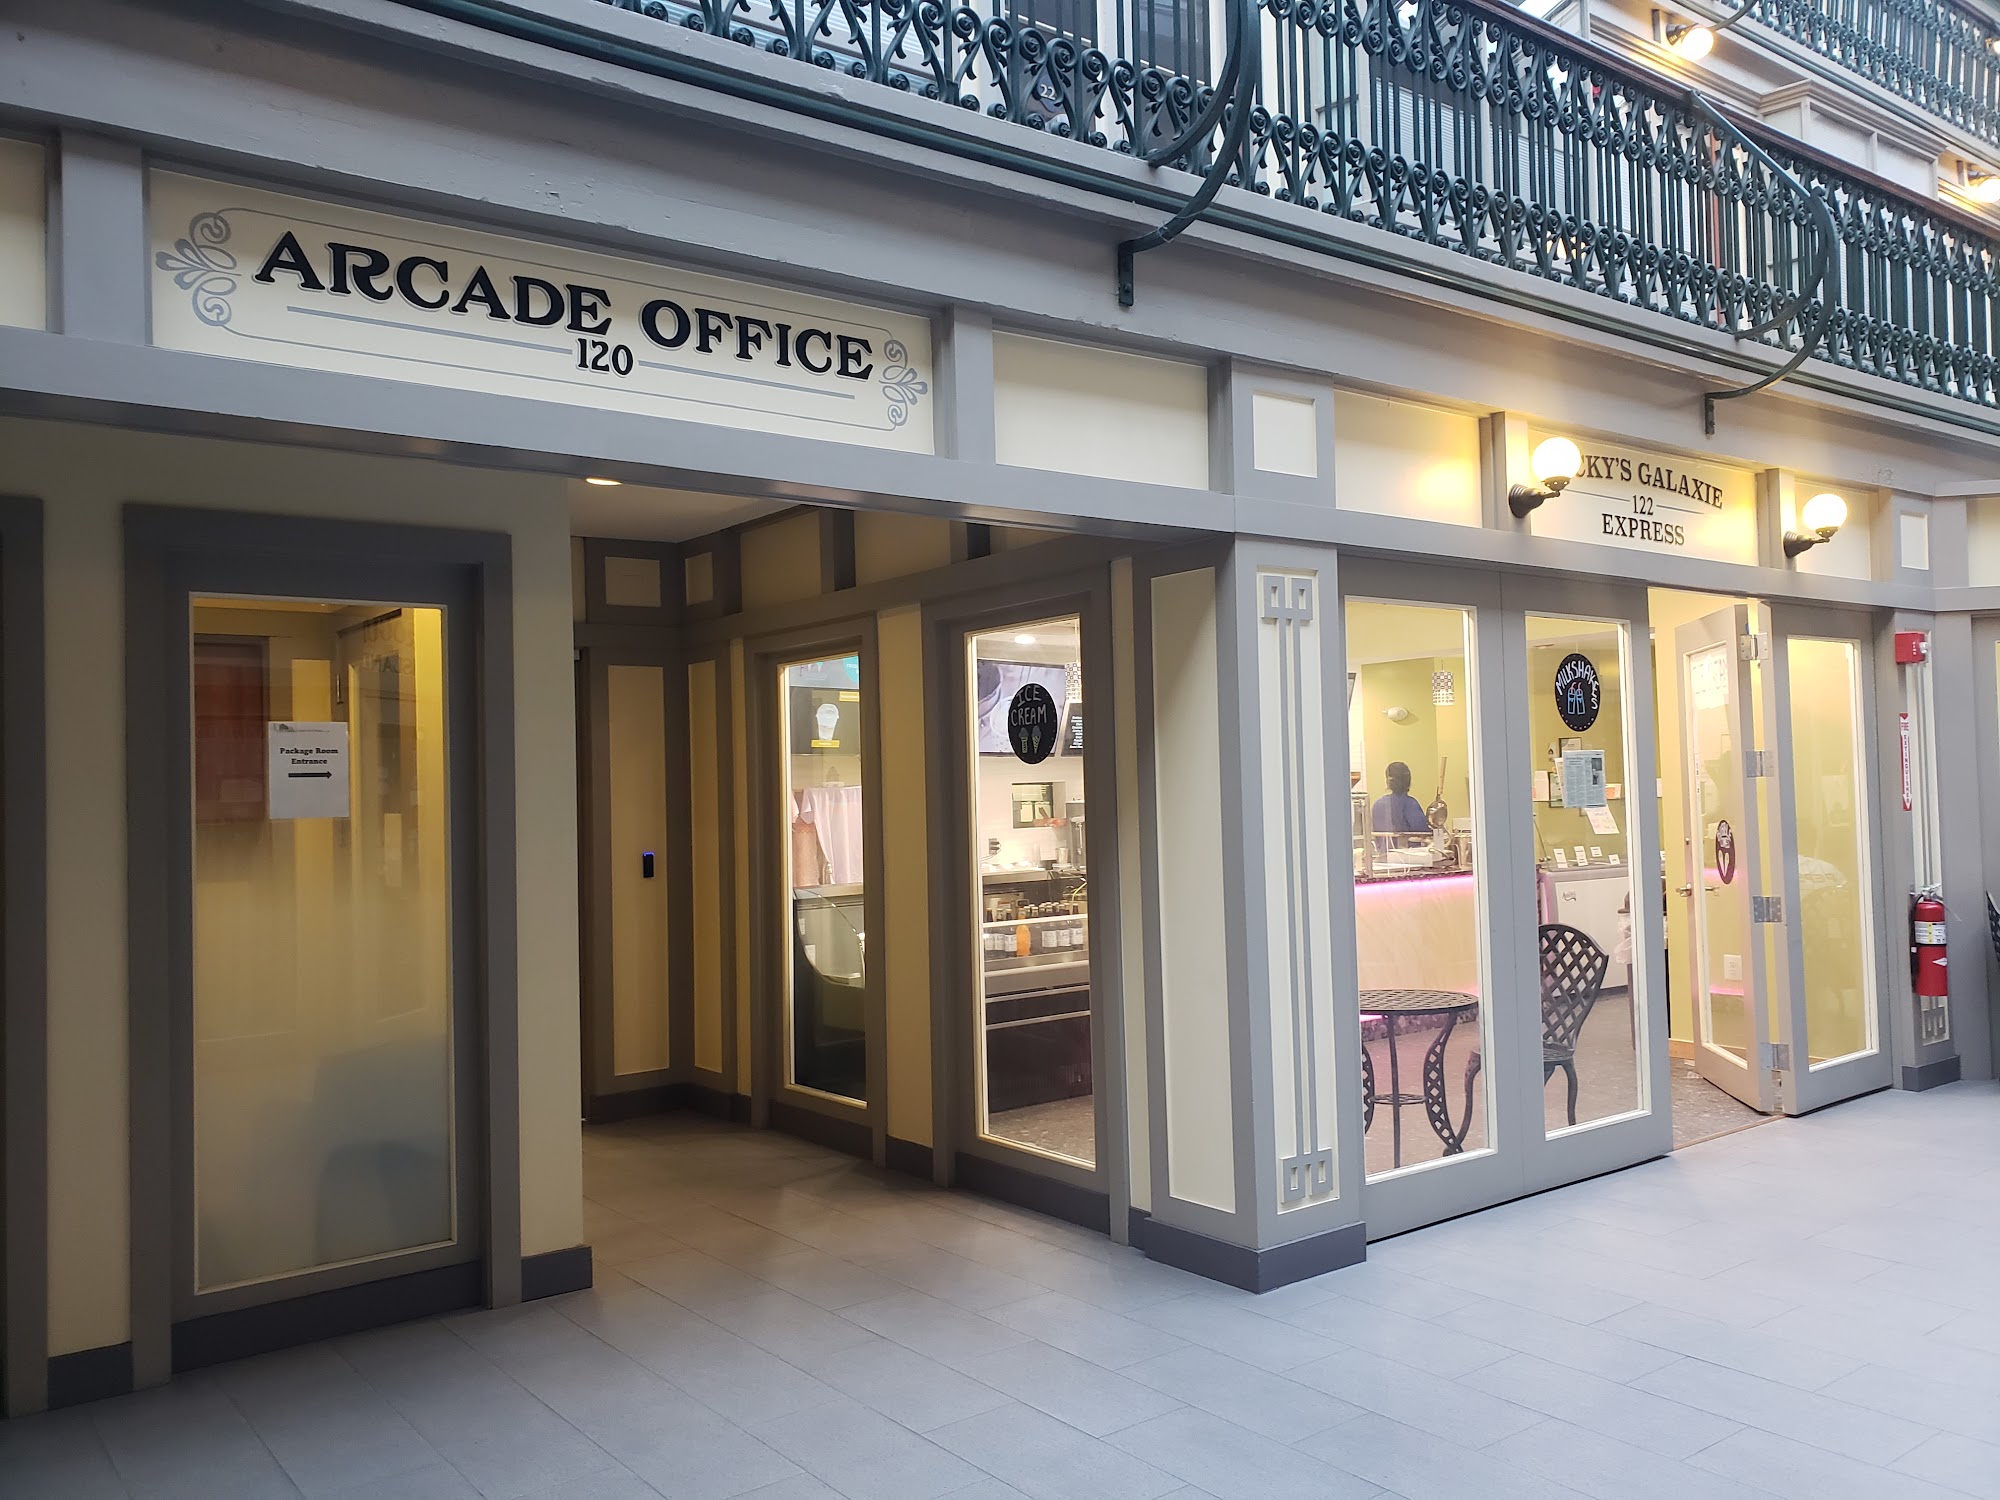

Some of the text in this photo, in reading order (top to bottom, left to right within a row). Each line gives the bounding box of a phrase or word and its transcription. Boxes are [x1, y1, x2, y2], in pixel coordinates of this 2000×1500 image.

[254, 231, 874, 381] ARCADE OFFICE
[576, 338, 634, 376] 120
[1575, 454, 1724, 510] CKY'S GALAXIE
[1632, 494, 1654, 516] 122
[1602, 513, 1685, 546] EXPRESS
[1016, 685, 1042, 707] ICE
[1556, 660, 1600, 709] MILKSHAKES
[1011, 704, 1047, 726] CREAM
[280, 747, 313, 756] Package
